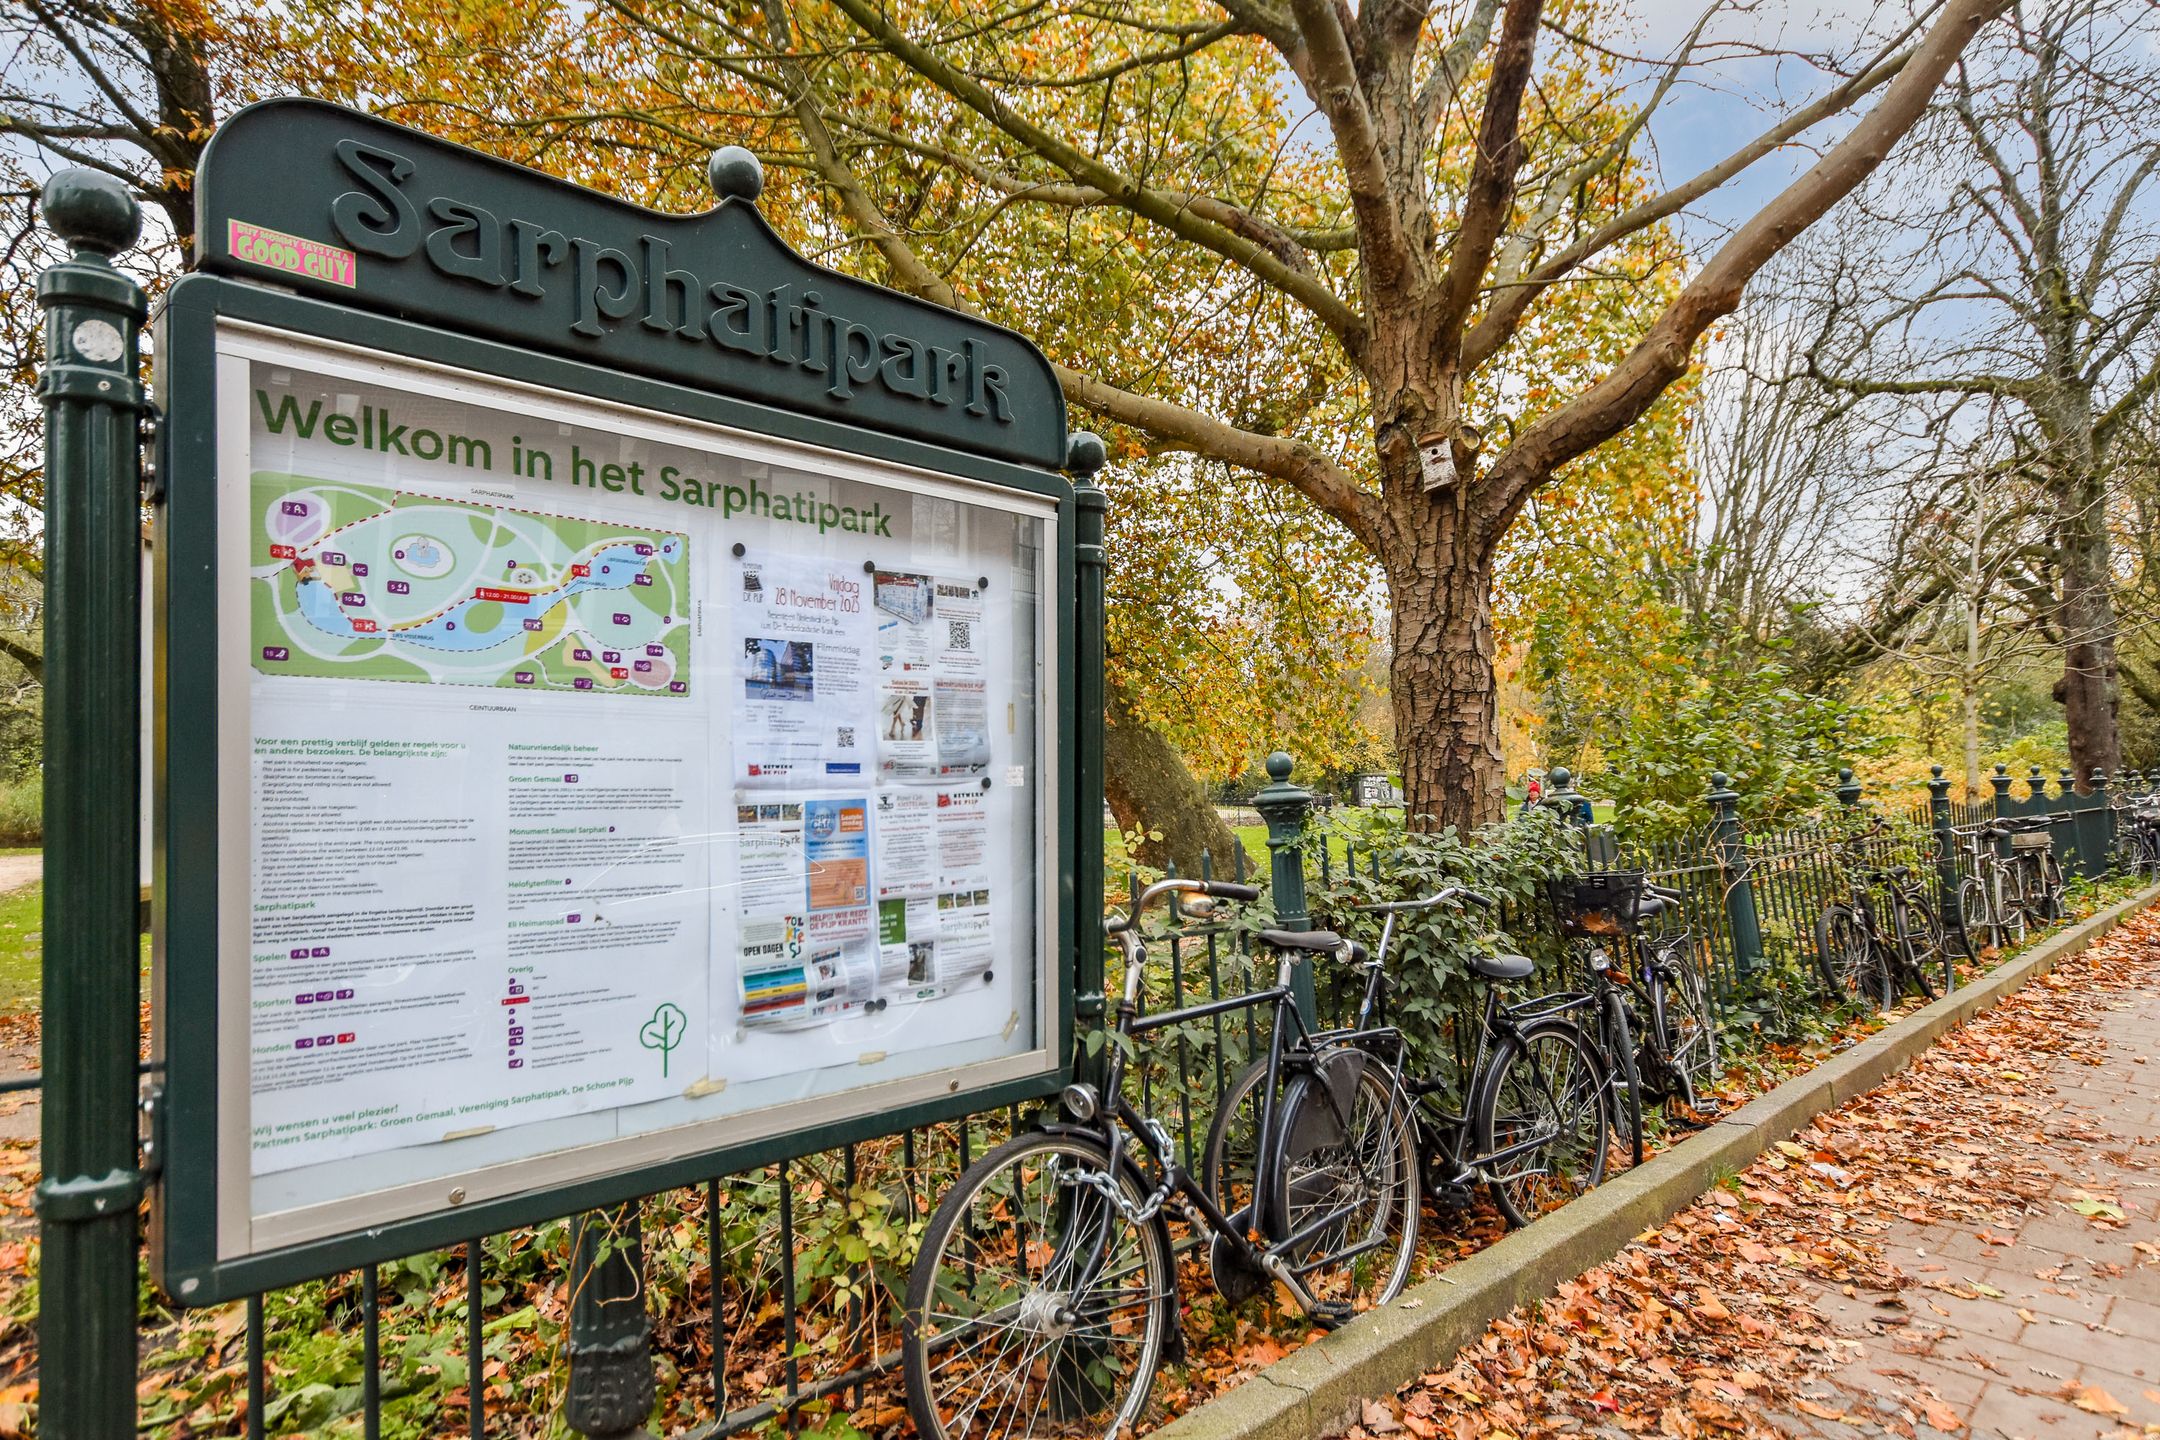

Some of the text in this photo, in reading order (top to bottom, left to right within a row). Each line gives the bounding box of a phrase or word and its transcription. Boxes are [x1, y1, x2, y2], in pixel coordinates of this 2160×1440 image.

[260, 230, 299, 247] MOMMY
[301, 241, 325, 254] SAYS
[238, 235, 349, 282] GOOD GUY
[331, 139, 1016, 424] Sarphatipark
[256, 389, 892, 537] Welkom in het Sarphatipark
[471, 488, 514, 500] SARPHATIPARK
[829, 573, 859, 597] Vrijdag
[776, 588, 860, 613] 28 November 2025
[817, 643, 860, 656] Filmmiddag
[469, 704, 516, 713] CEINTUURBAAN
[254, 737, 278, 745] Voor
[301, 738, 333, 747] prettig
[336, 739, 368, 748] verblijf
[370, 740, 400, 748] gelden
[508, 744, 571, 752] Natuurvriendelijk
[374, 749, 428, 758] belangrijkste
[508, 880, 562, 888] Helofytenfilter
[254, 901, 315, 912] Sarphatipark
[821, 920, 836, 928] PIJP
[744, 943, 783, 957] OPEN DAGEN
[253, 953, 286, 962] Spelen
[508, 966, 533, 974] Overig
[253, 999, 292, 1010] Sporten
[253, 1044, 292, 1054] Honden
[253, 1135, 301, 1150] Partners
[304, 1122, 377, 1141] Sarphatipark:
[380, 1116, 413, 1128] Groen
[416, 1108, 456, 1121] Gemaal,
[459, 1094, 509, 1114] Vereniging
[511, 1088, 570, 1104] Sarphatipark,
[586, 1079, 616, 1091] Schone
[618, 1077, 634, 1088] Pijp
[253, 1125, 272, 1136] Wij
[276, 1117, 319, 1132] wensen
[332, 1112, 355, 1122] veel
[358, 1104, 398, 1120] plezier!
